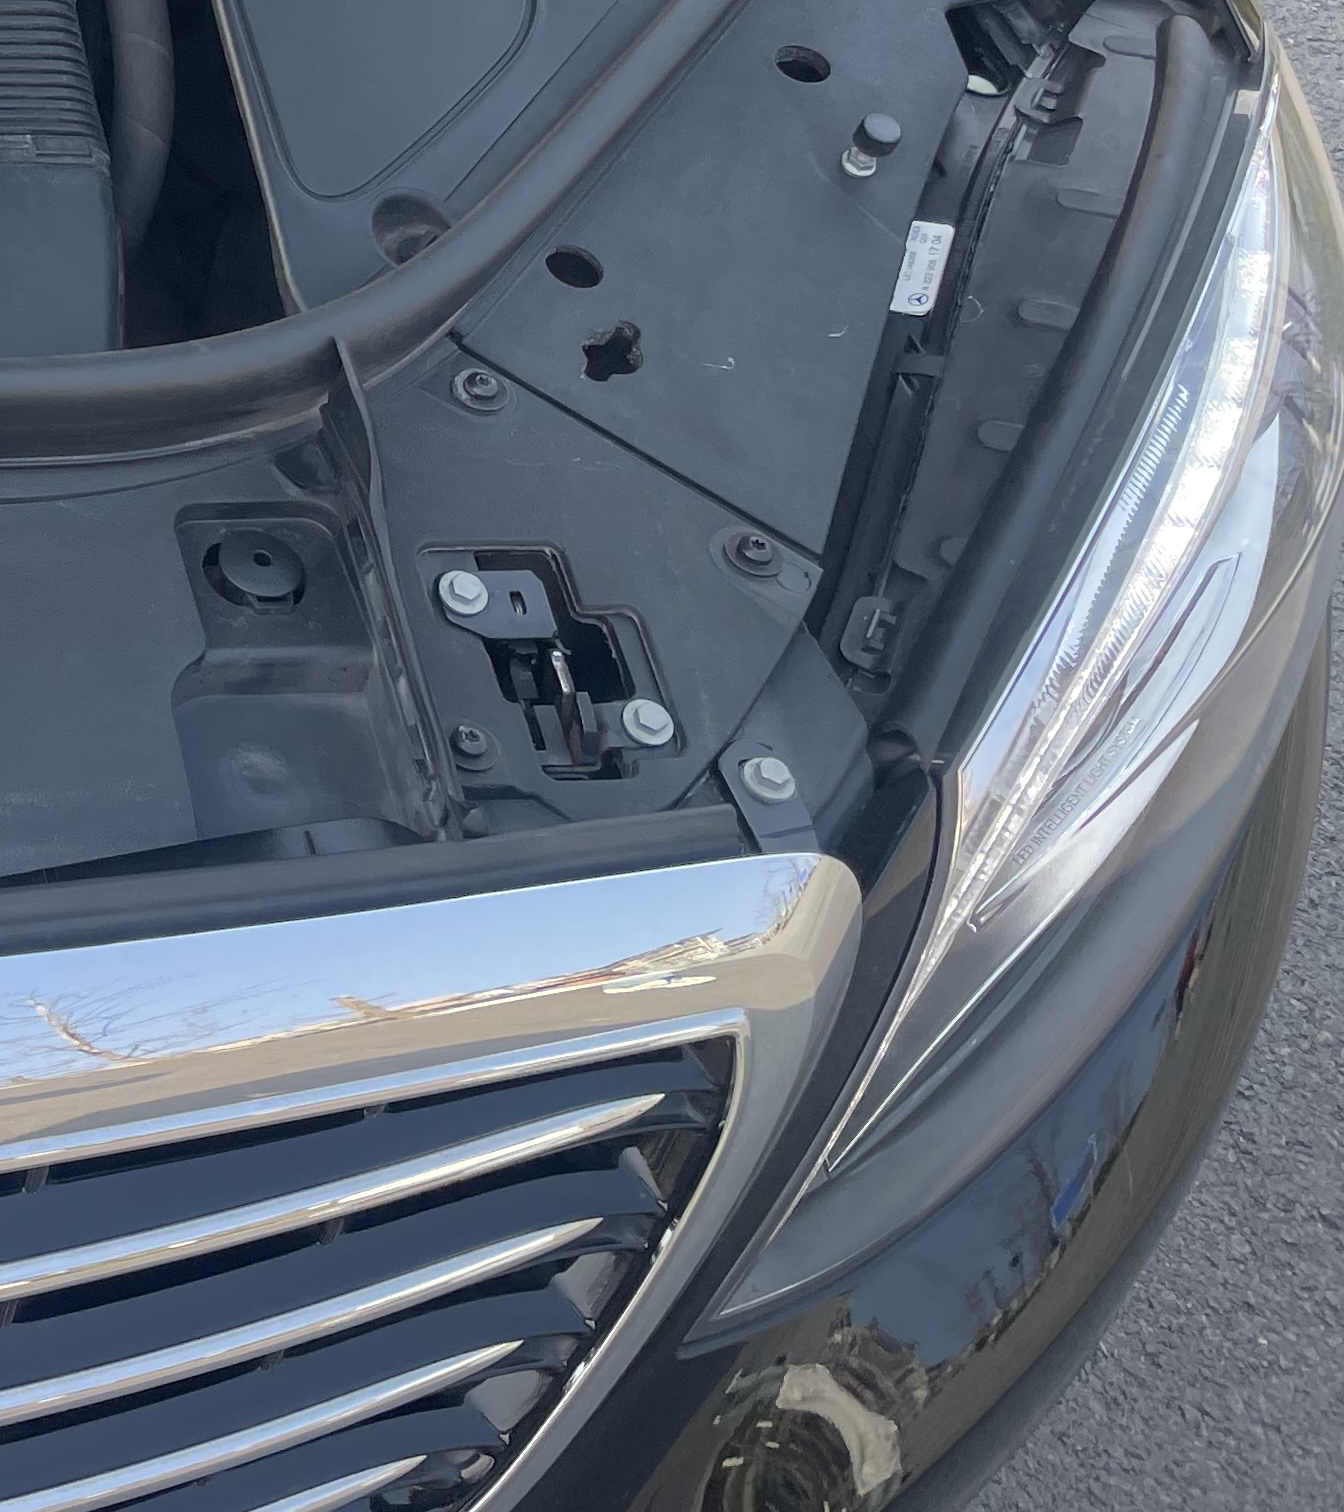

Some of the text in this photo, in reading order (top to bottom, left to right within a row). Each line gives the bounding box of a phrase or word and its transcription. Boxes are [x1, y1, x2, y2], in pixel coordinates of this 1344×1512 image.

[1012, 716, 1141, 866] LED INTELLIGENT LIGHT SYSTEM
